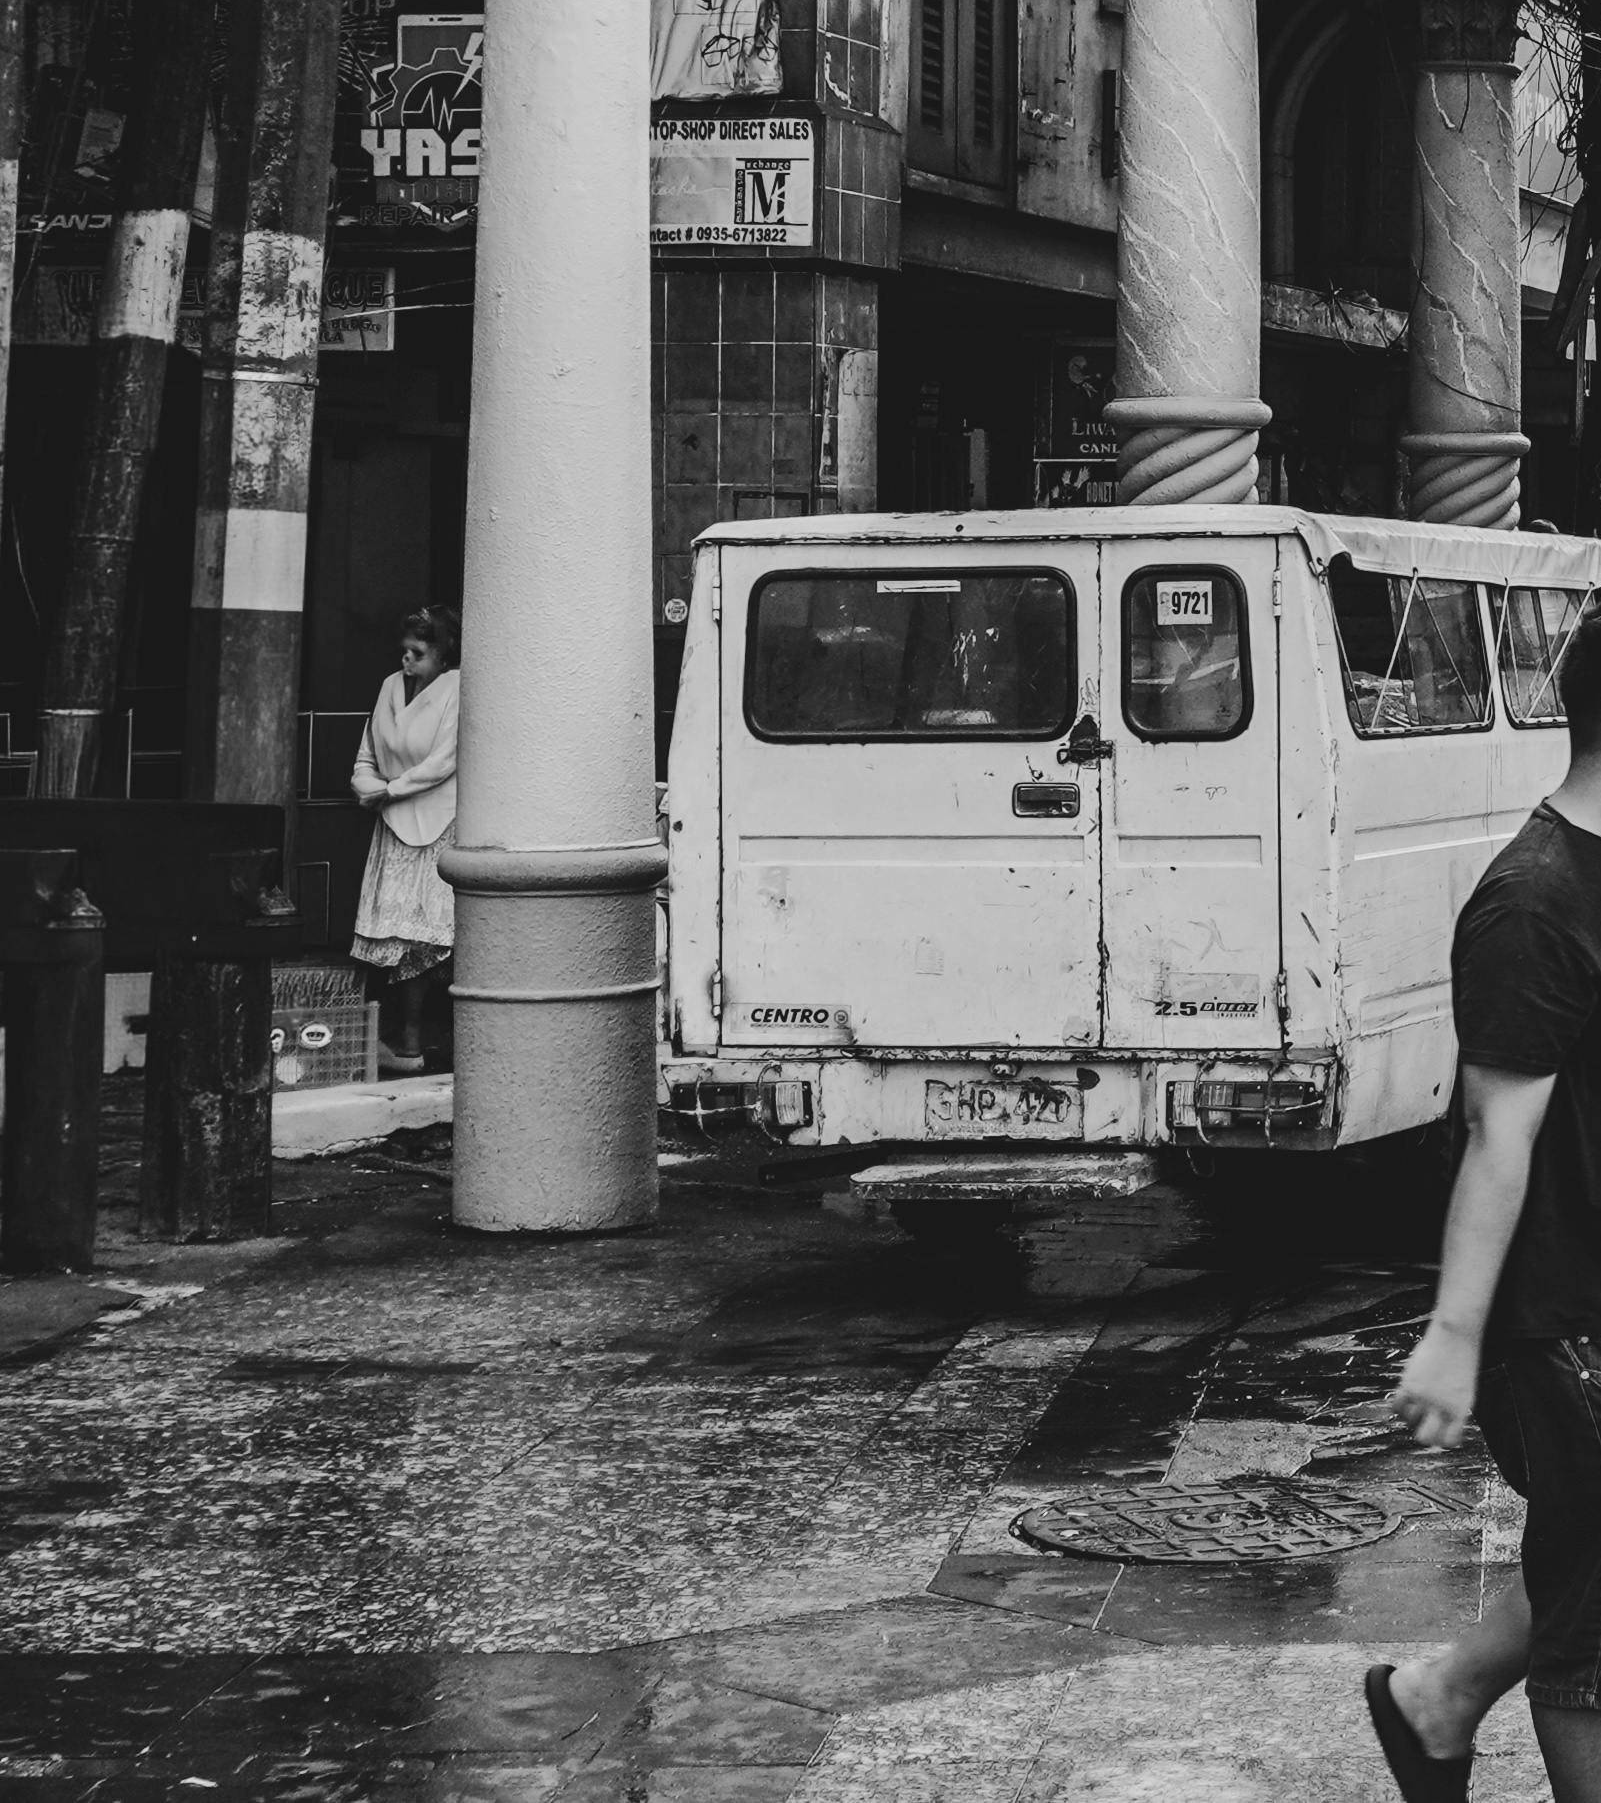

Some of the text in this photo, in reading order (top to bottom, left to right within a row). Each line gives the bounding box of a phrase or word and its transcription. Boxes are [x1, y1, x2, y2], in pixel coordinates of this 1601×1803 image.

[650, 121, 810, 141] TOP-SHOP DIRECT SALES
[696, 227, 788, 244] 0935-6713822
[1171, 591, 1209, 615] 9721
[750, 1007, 830, 1024] CENTRO
[1154, 1000, 1198, 1017] 2.5
